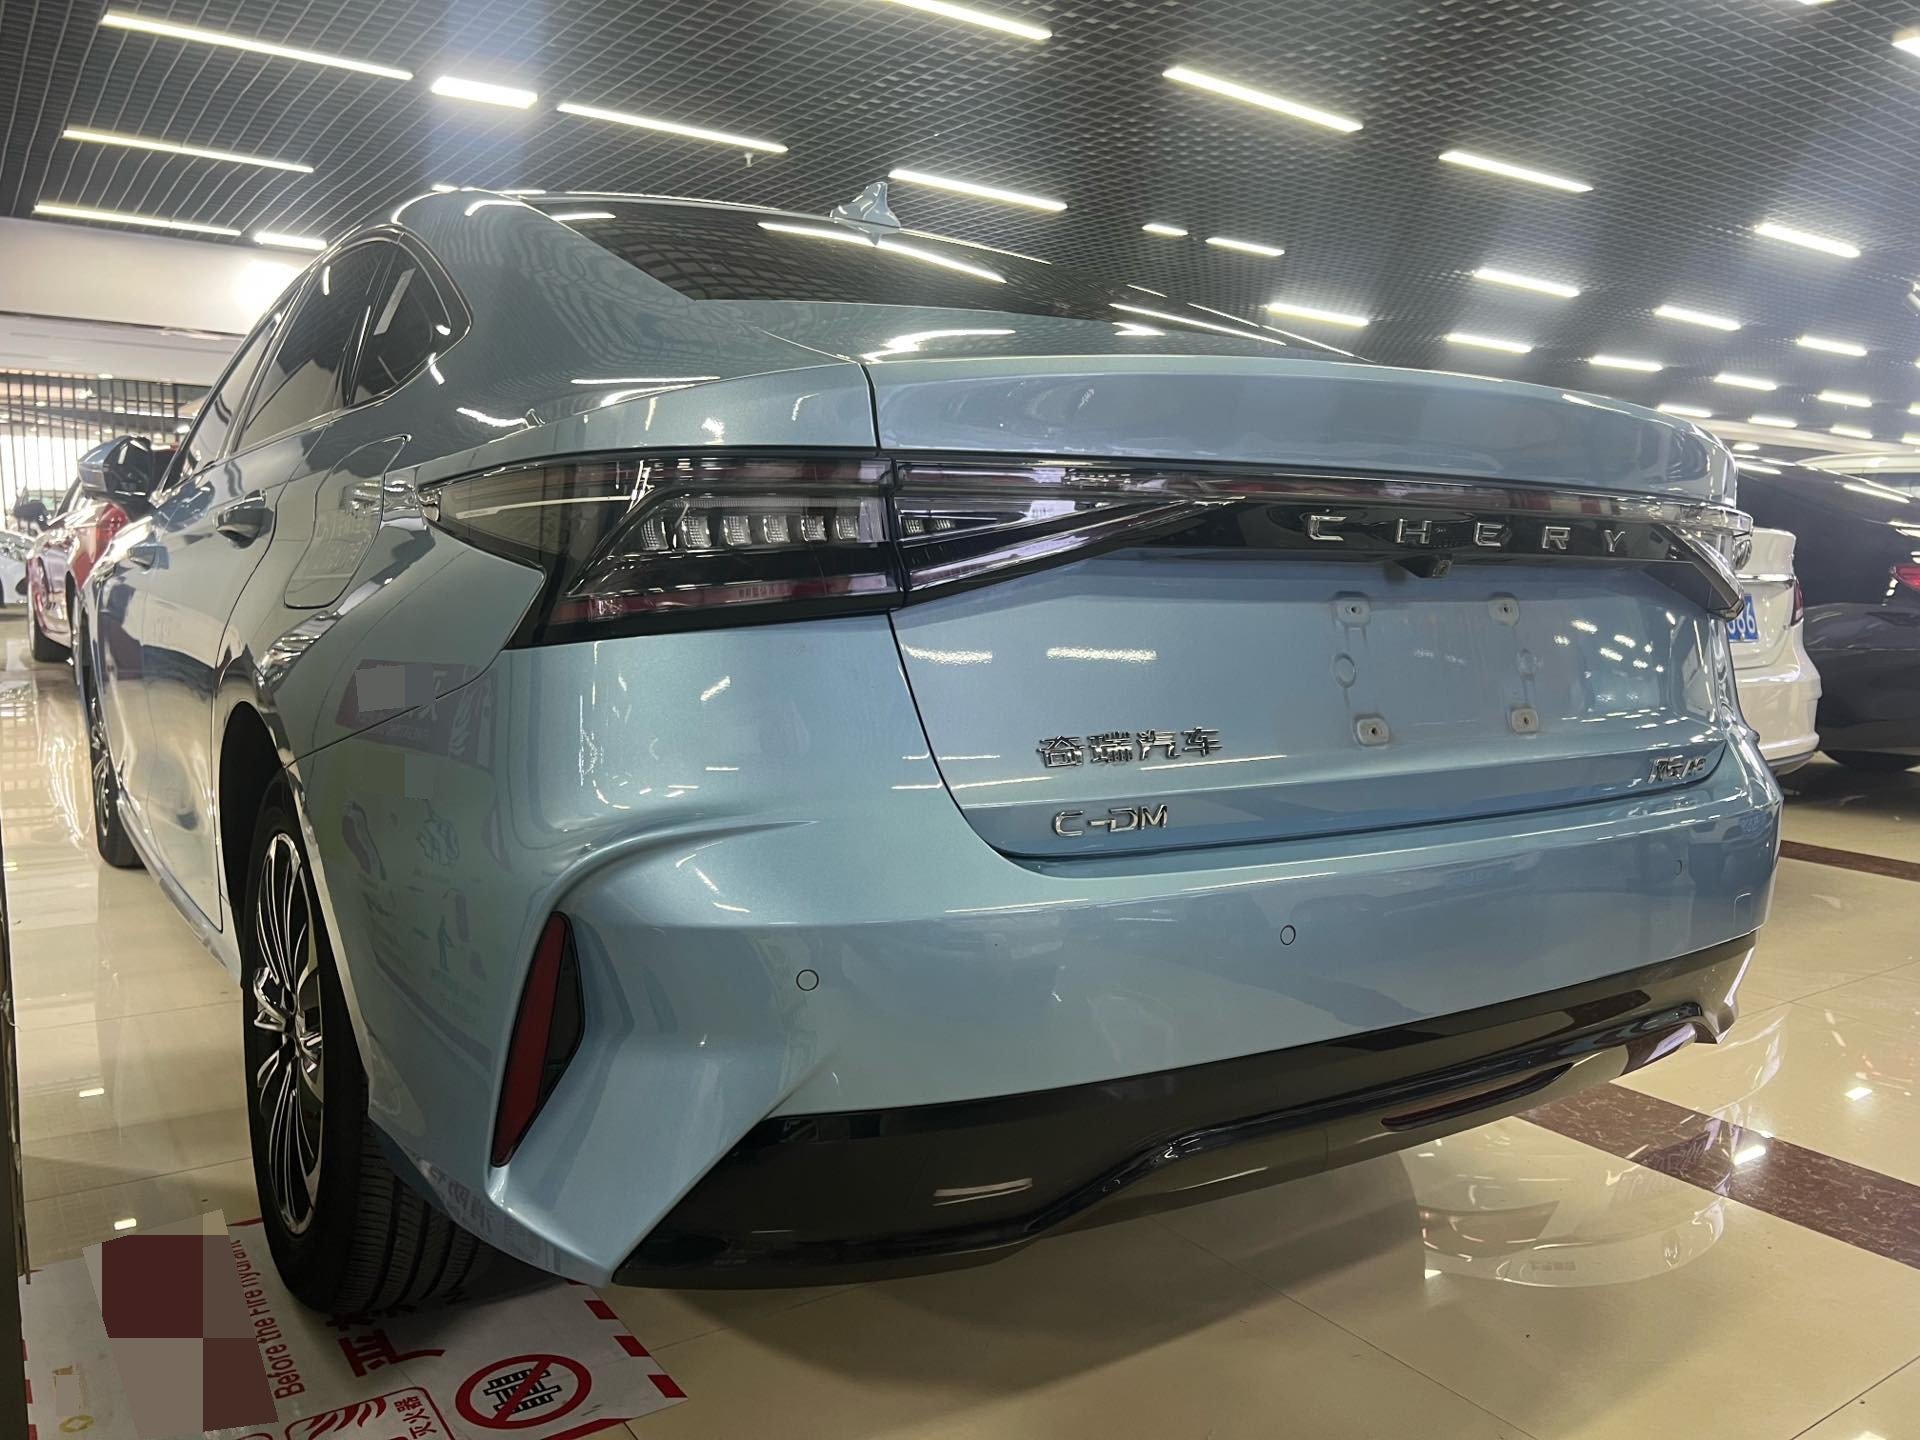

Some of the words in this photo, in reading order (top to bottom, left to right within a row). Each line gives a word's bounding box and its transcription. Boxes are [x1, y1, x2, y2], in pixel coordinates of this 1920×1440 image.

[1307, 514, 1626, 553] CHERY
[1037, 726, 1222, 768] 奇瑞汽车
[1054, 804, 1168, 837] C-DM
[253, 1316, 283, 1344] the
[264, 1343, 306, 1400] Before
[394, 1396, 438, 1440] 灭火器
